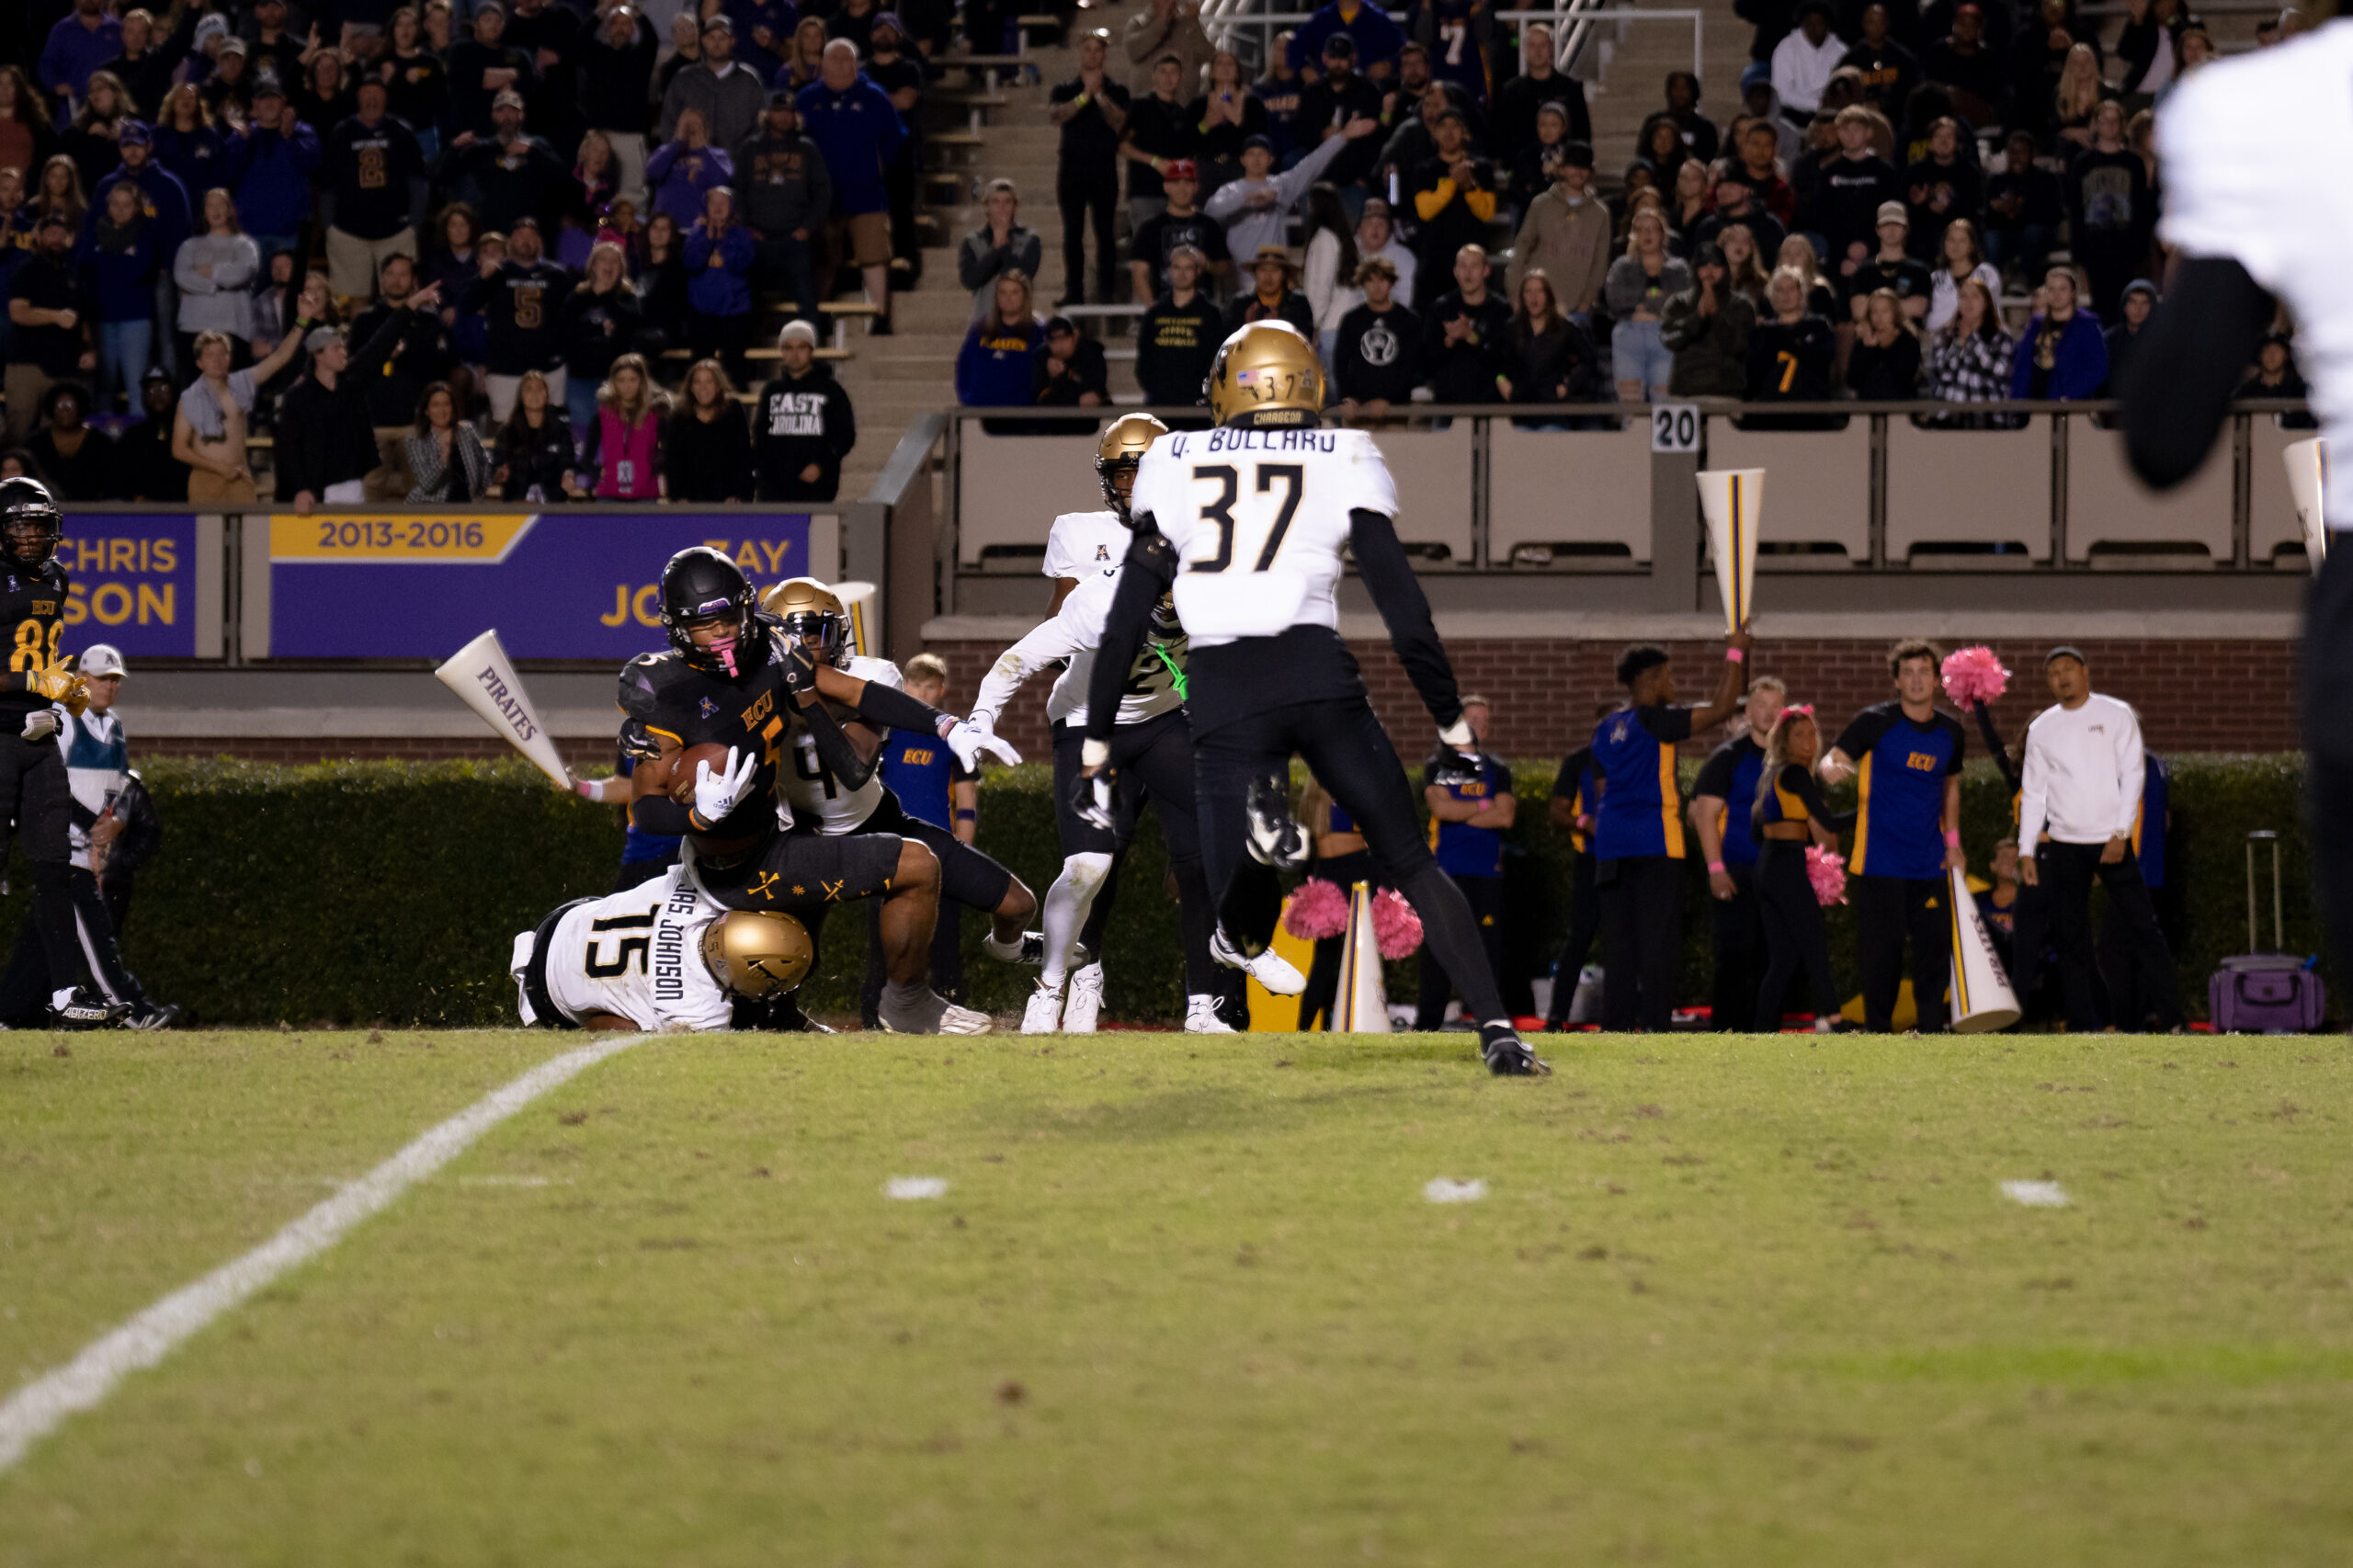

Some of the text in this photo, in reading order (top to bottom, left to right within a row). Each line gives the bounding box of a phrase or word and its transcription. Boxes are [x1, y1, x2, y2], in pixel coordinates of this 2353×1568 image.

[1440, 24, 1466, 64] 7
[358, 147, 387, 189] 2
[515, 286, 543, 329] 5
[1777, 350, 1798, 392] 7
[769, 392, 827, 414] EAST
[1656, 410, 1695, 448] 20
[318, 521, 484, 549] 2013-2016
[1188, 463, 1306, 574] 37
[476, 665, 538, 742] PIRATES
[741, 689, 773, 733] ECU
[903, 748, 936, 766] ECU
[1906, 752, 1937, 772] ECU
[584, 903, 660, 982] 15
[654, 918, 686, 1001] JOHNSON
